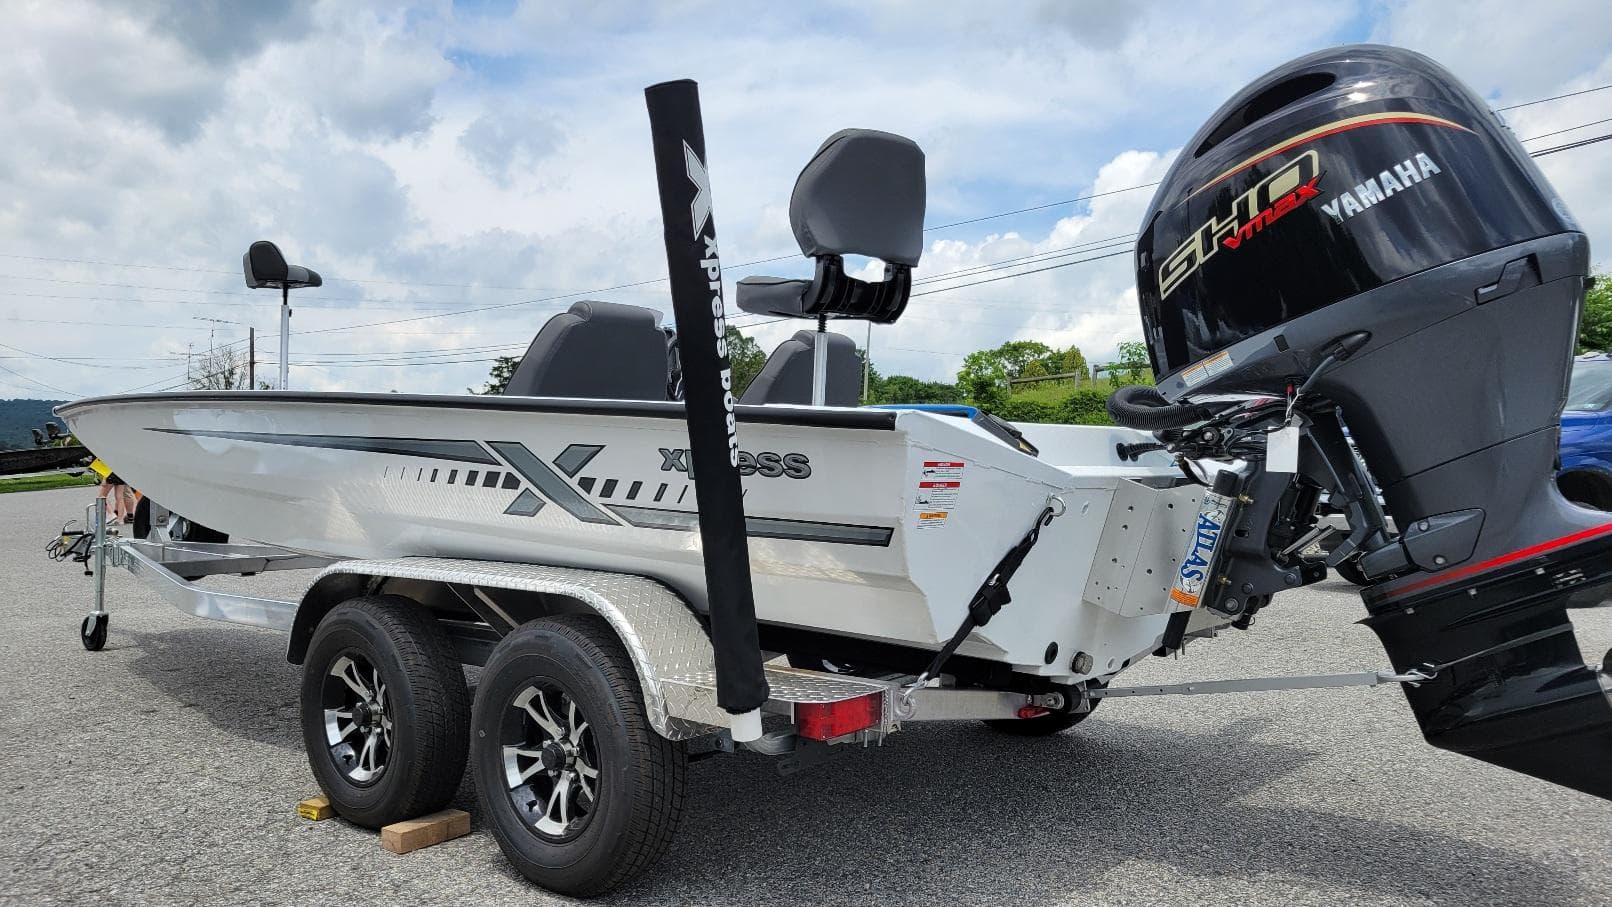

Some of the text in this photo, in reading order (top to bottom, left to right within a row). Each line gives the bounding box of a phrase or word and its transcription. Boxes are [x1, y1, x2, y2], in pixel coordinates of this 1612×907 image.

[1158, 149, 1320, 300] SHO
[1321, 152, 1442, 225] YAMAHA
[700, 234, 727, 359] xpress
[1180, 513, 1222, 582] ATLAS
